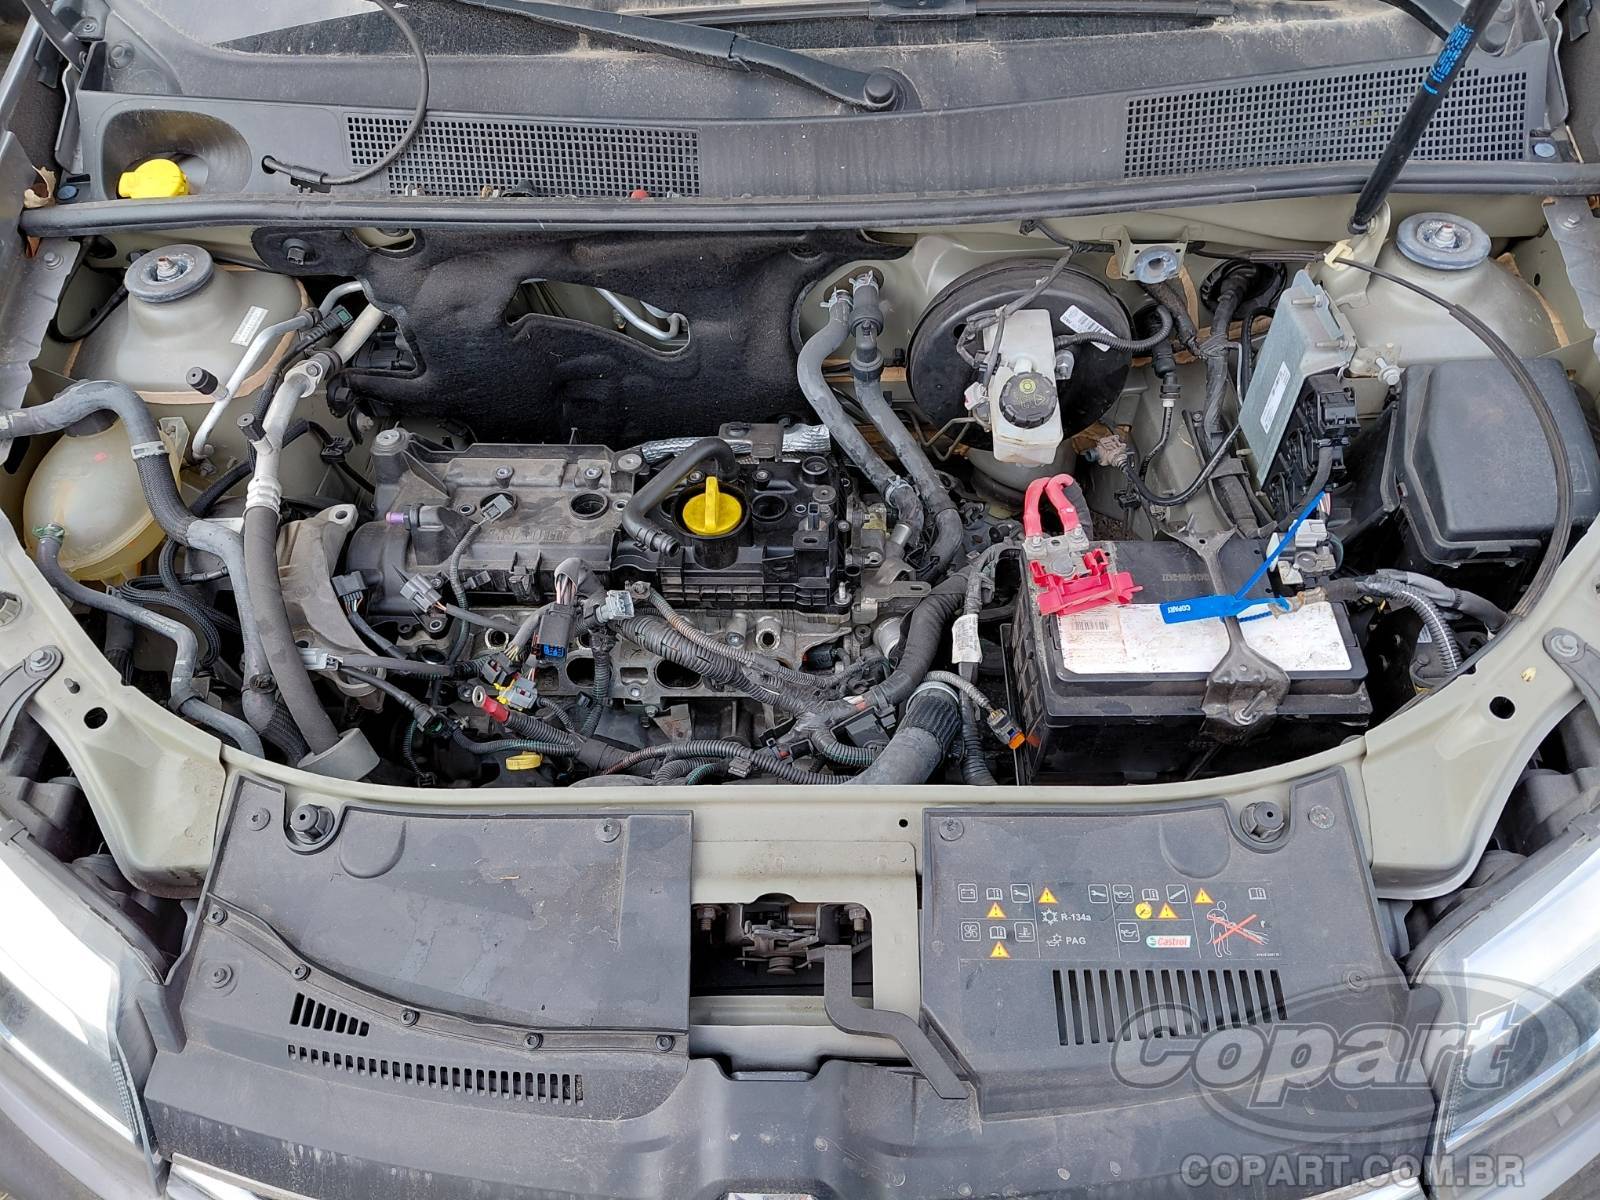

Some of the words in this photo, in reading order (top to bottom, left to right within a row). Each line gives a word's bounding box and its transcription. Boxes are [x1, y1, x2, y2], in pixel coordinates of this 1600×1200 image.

[1060, 912, 1092, 922] R-134a
[1065, 936, 1087, 946] PAG
[1157, 936, 1188, 946] Castrol
